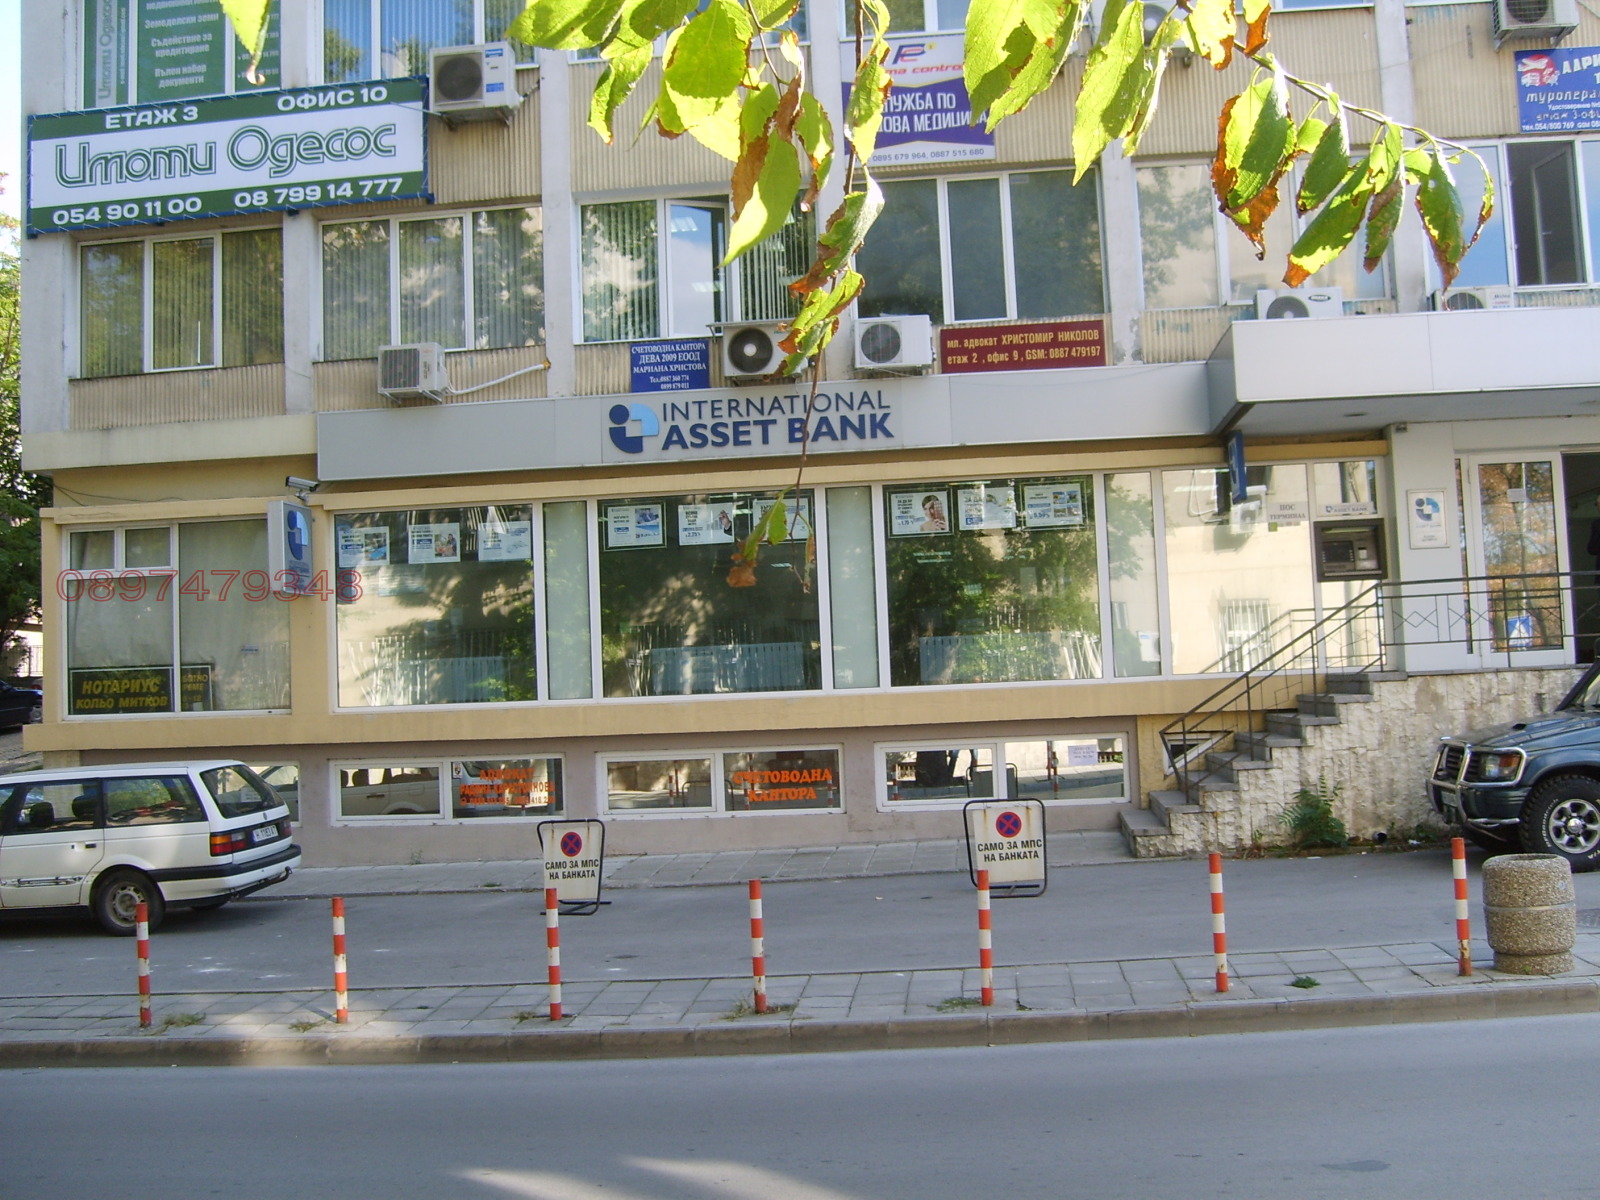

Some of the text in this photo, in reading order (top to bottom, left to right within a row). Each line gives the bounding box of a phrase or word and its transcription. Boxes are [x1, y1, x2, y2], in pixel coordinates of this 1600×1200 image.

[912, 63, 965, 74] contro
[884, 92, 956, 113] ЛУЖБА ПО
[1525, 90, 1600, 104] туропера
[105, 86, 388, 130] ЕТАЖ 3 ОФИС 10
[913, 110, 989, 132] МЕДИЦИА
[55, 124, 396, 188] Имоти Одесос
[52, 177, 403, 225] 054 90 11 00 08 799 14 777
[964, 336, 998, 350] адвокат
[1001, 331, 1054, 345] ХРИСТОМИР
[1058, 329, 1099, 342] НИКОЛОВ
[631, 343, 706, 354] СЧЕТОВОДНА КАНТОРА
[947, 355, 969, 365] етаж
[972, 353, 978, 363] 2
[987, 351, 1009, 364] офис
[1050, 347, 1069, 360] 0887
[1071, 346, 1101, 358] 479197
[639, 351, 701, 365] ДЕВА 2009 ЕООД
[633, 363, 706, 374] МАРИАНА ХРИСТОВА
[662, 390, 891, 422] INTERNATIONAL
[661, 412, 895, 451] ASSET BANK
[82, 677, 161, 694] НОТАРИУС
[76, 696, 168, 709] КОЛЬО МИТКОВ
[480, 767, 534, 781] АДВОКАТ
[733, 768, 832, 784] СЧЕТОВОДНА
[748, 787, 817, 802] КАНТОРА
[977, 839, 1042, 852] САМО ЗА МПС
[983, 850, 1039, 862] НА БАНКАТА
[545, 859, 599, 870] САМО ЗА МПС
[549, 870, 596, 880] НА БАНКАТА
